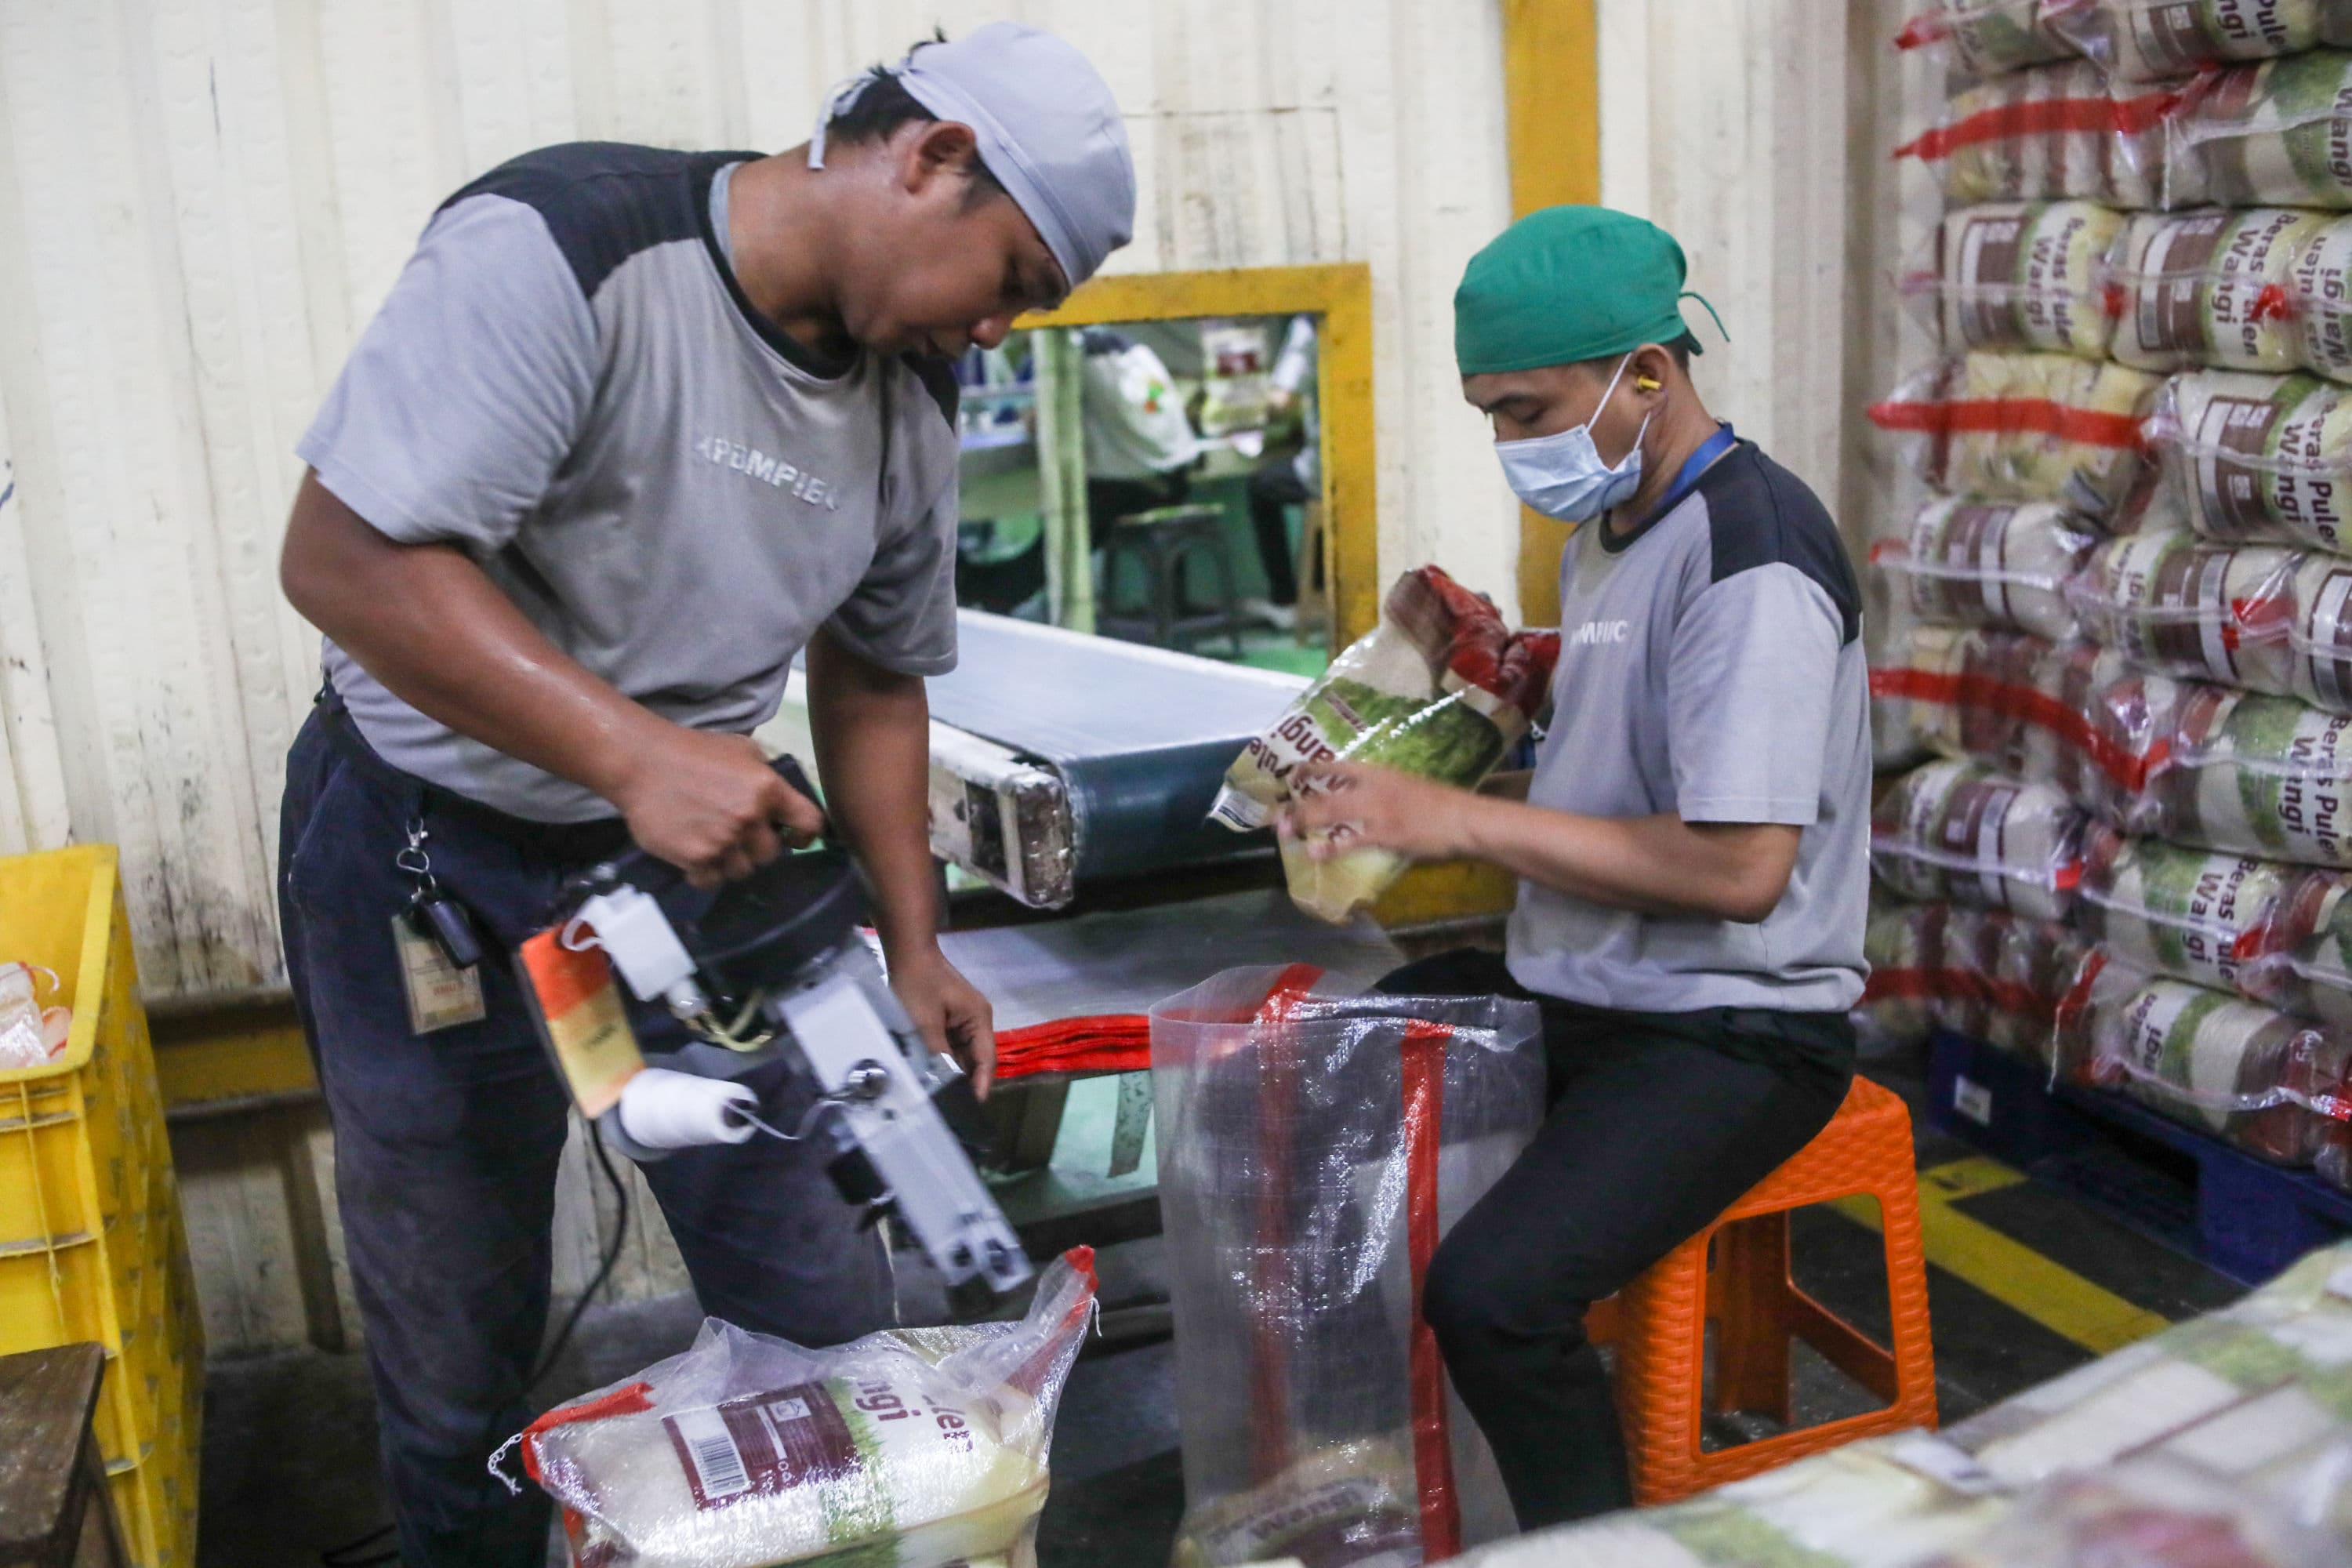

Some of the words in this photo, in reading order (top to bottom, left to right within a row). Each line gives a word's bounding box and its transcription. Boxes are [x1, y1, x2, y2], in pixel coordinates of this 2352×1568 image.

[2249, 213, 2299, 272] Beras
[2296, 236, 2327, 294] ulen
[2242, 299, 2259, 357] ulen
[2308, 481, 2339, 545] Pule
